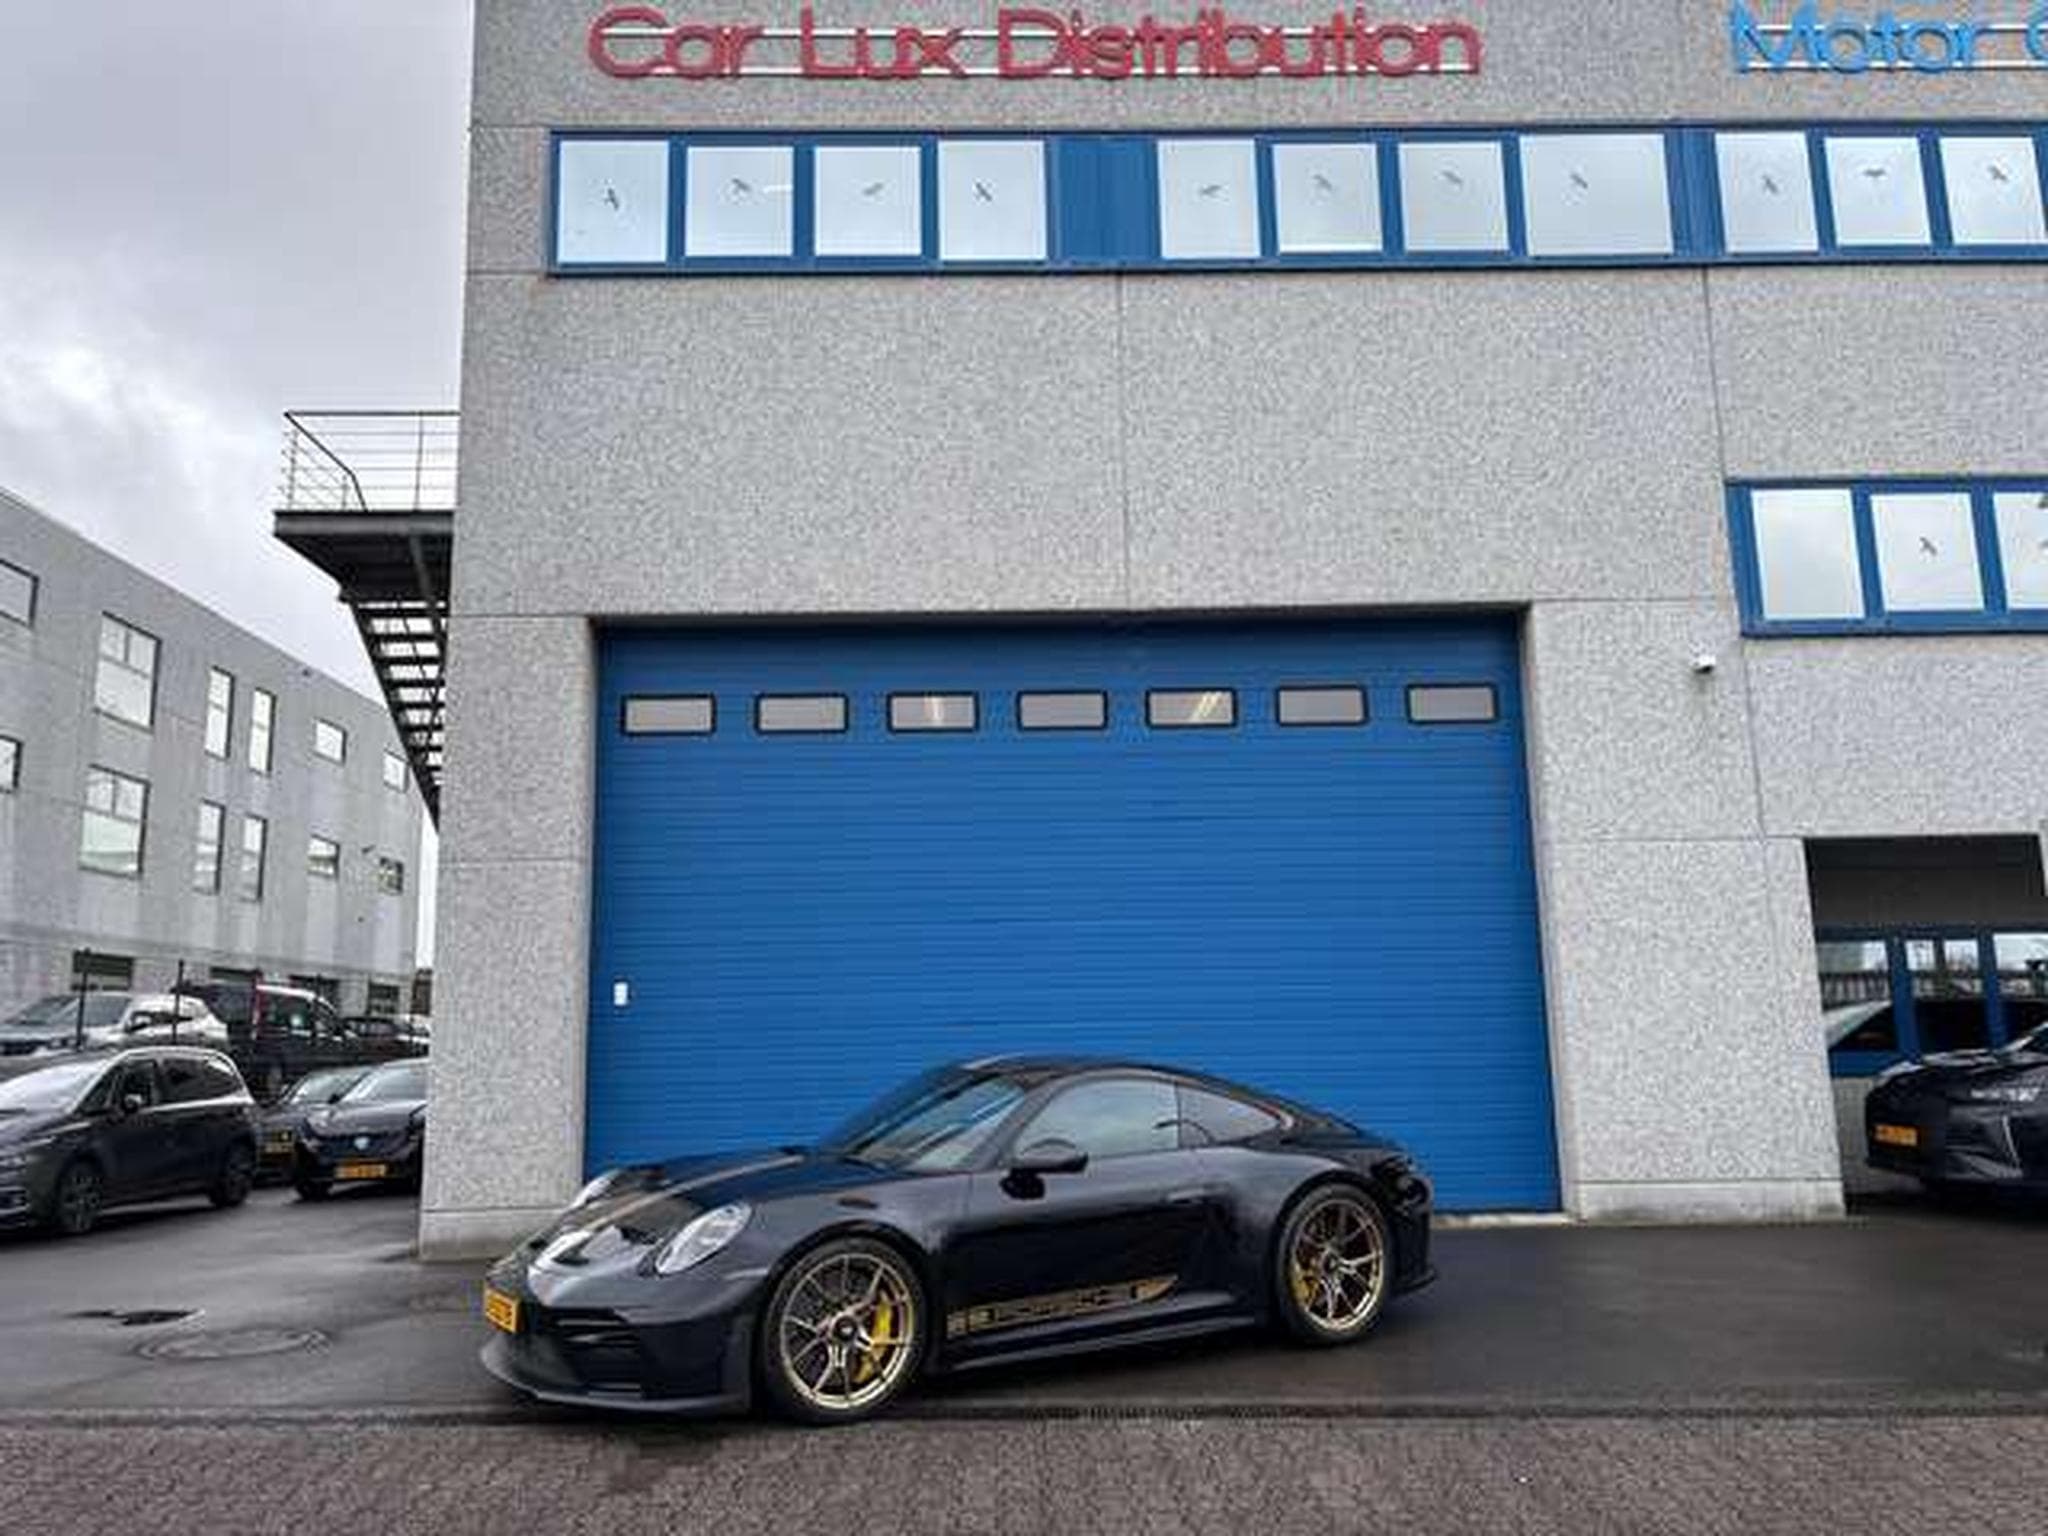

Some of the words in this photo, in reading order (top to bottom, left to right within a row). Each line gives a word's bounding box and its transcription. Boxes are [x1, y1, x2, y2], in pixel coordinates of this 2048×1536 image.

[587, 5, 764, 79] Car
[800, 2, 966, 79] Lux
[1000, 6, 1482, 80] Distribution
[1731, 0, 1978, 74] Motor
